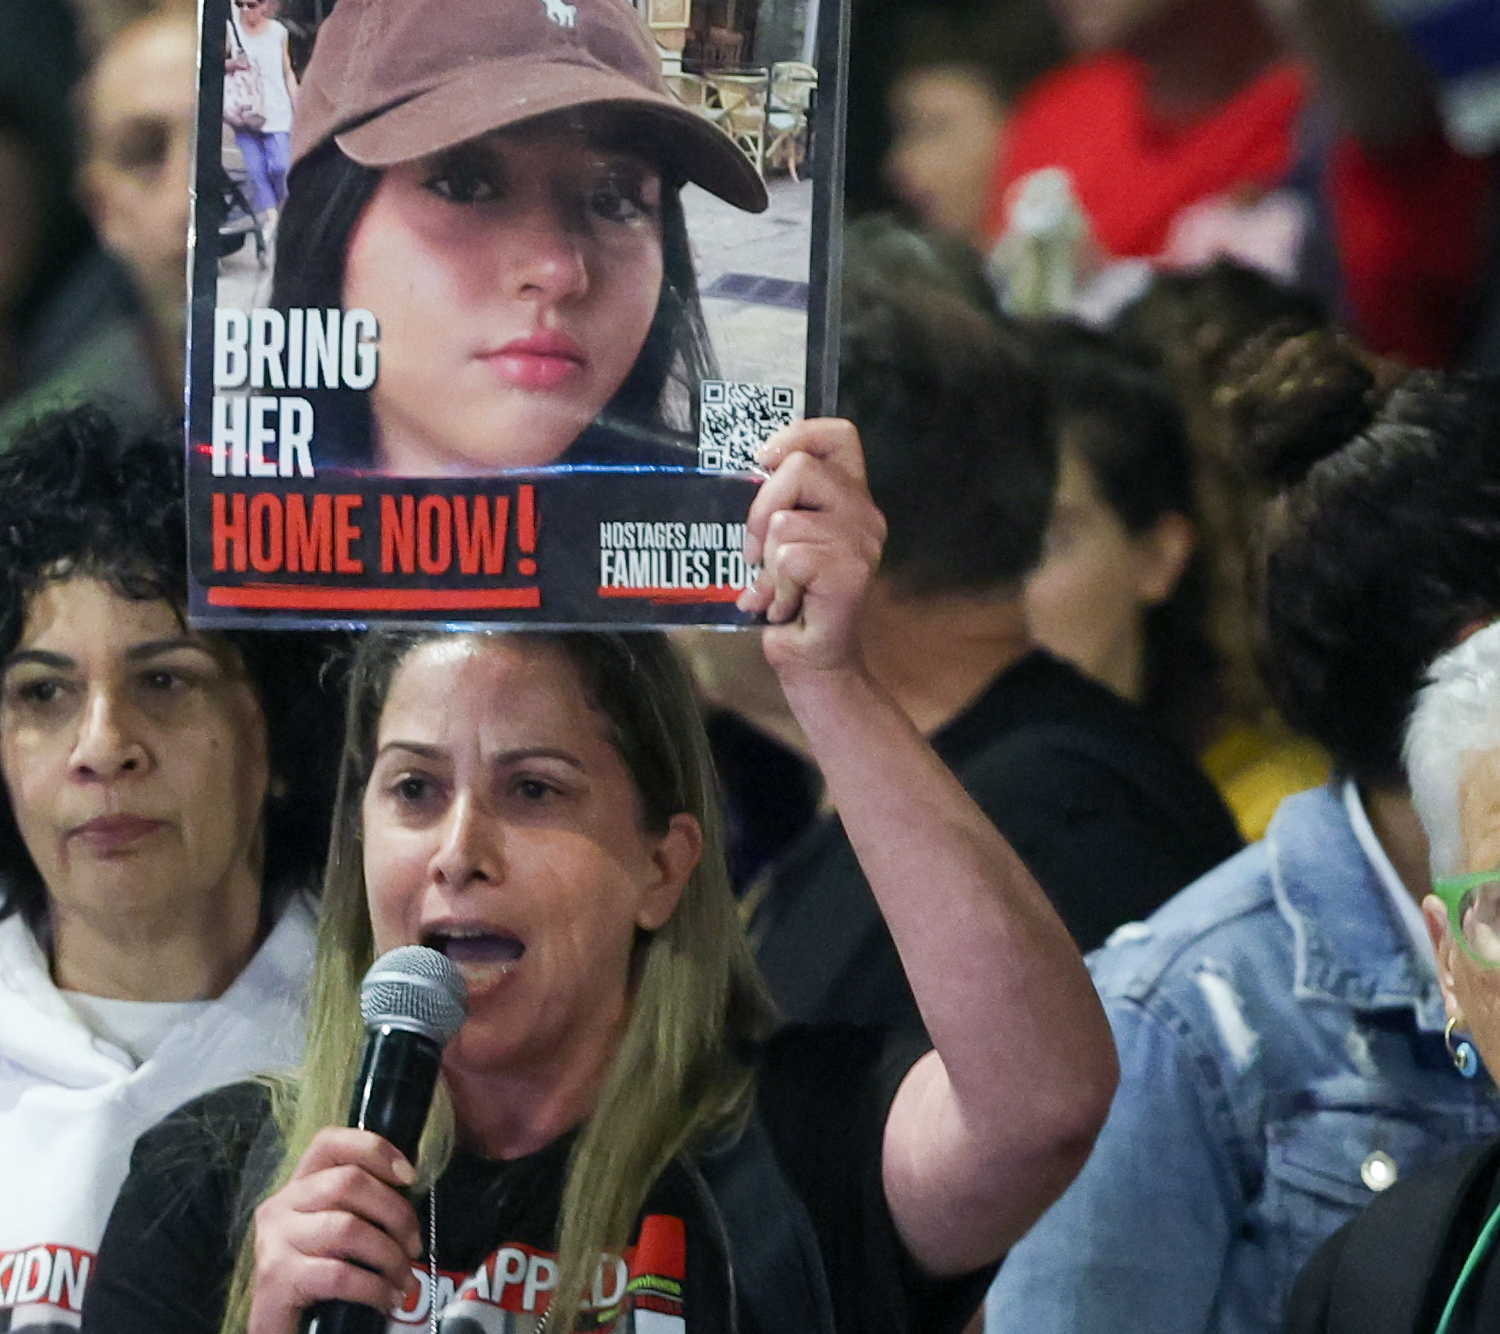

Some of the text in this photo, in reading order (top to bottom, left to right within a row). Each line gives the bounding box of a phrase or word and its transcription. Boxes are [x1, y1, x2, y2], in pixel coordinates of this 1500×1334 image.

[213, 307, 379, 390] BRING
[211, 396, 316, 478] HER
[211, 485, 540, 576] HOME NOW!
[600, 521, 687, 550] HOSTAGES
[688, 523, 724, 550] AND
[600, 549, 710, 590] FAMILIES
